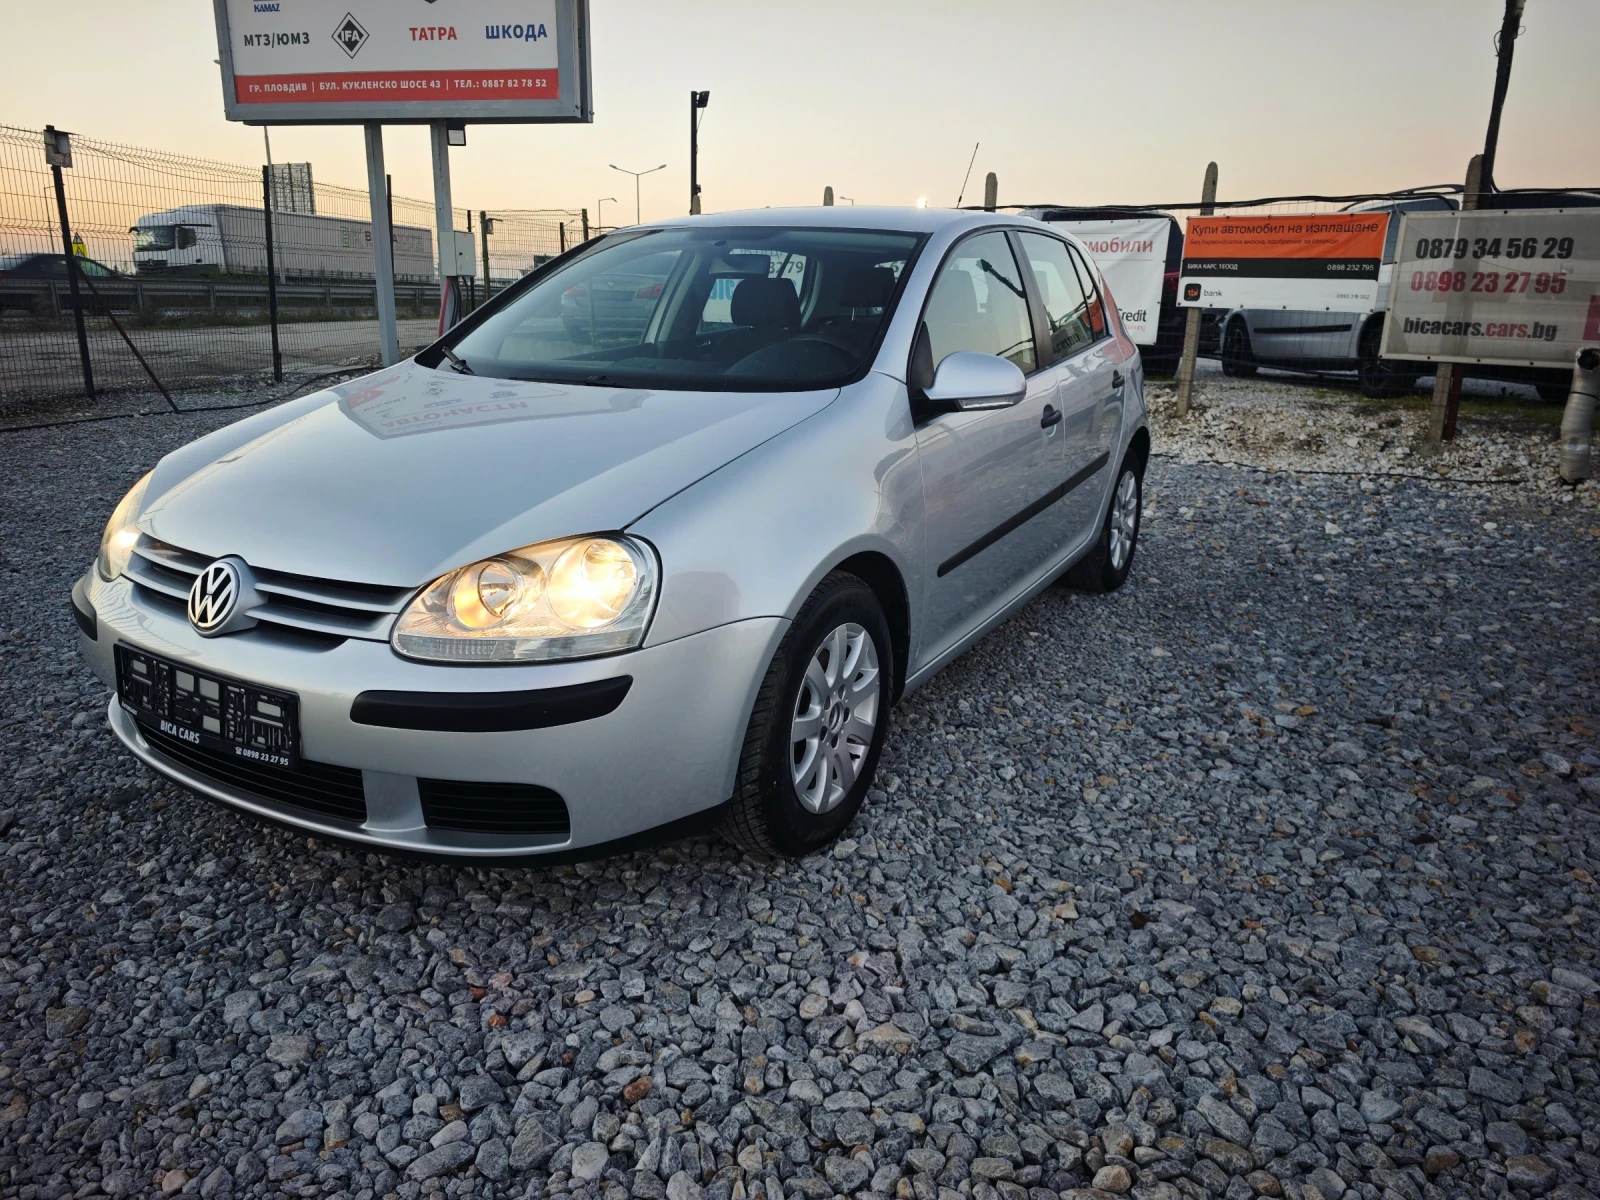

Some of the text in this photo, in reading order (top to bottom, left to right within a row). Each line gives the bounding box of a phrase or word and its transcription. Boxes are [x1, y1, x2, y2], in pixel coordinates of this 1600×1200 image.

[254, 3, 280, 12] KAMAZ
[244, 32, 310, 48] МТЗ/ЮМЗ
[340, 30, 360, 42] IFA
[409, 26, 457, 41] ТАТРА
[485, 24, 547, 42] ШКОДА
[249, 78, 547, 93] ГР. ПЛОВДИВ БУЛ. КУКЛЕНСКО ШОСЕ 43 ТЕЛ.: 0887 82 78 52
[1192, 223, 1379, 236] Купи автомобил на изплащане
[1415, 237, 1575, 260] 0879 34 56 29
[1326, 263, 1346, 271] 0898
[1346, 263, 1360, 271] 232
[1410, 270, 1568, 294] 0898 23 27 95
[1203, 288, 1223, 297] bank
[1403, 317, 1558, 341] bicacars.cars.bg
[160, 720, 200, 744] BICA CARS
[242, 749, 289, 766] 0898 23 27 95
